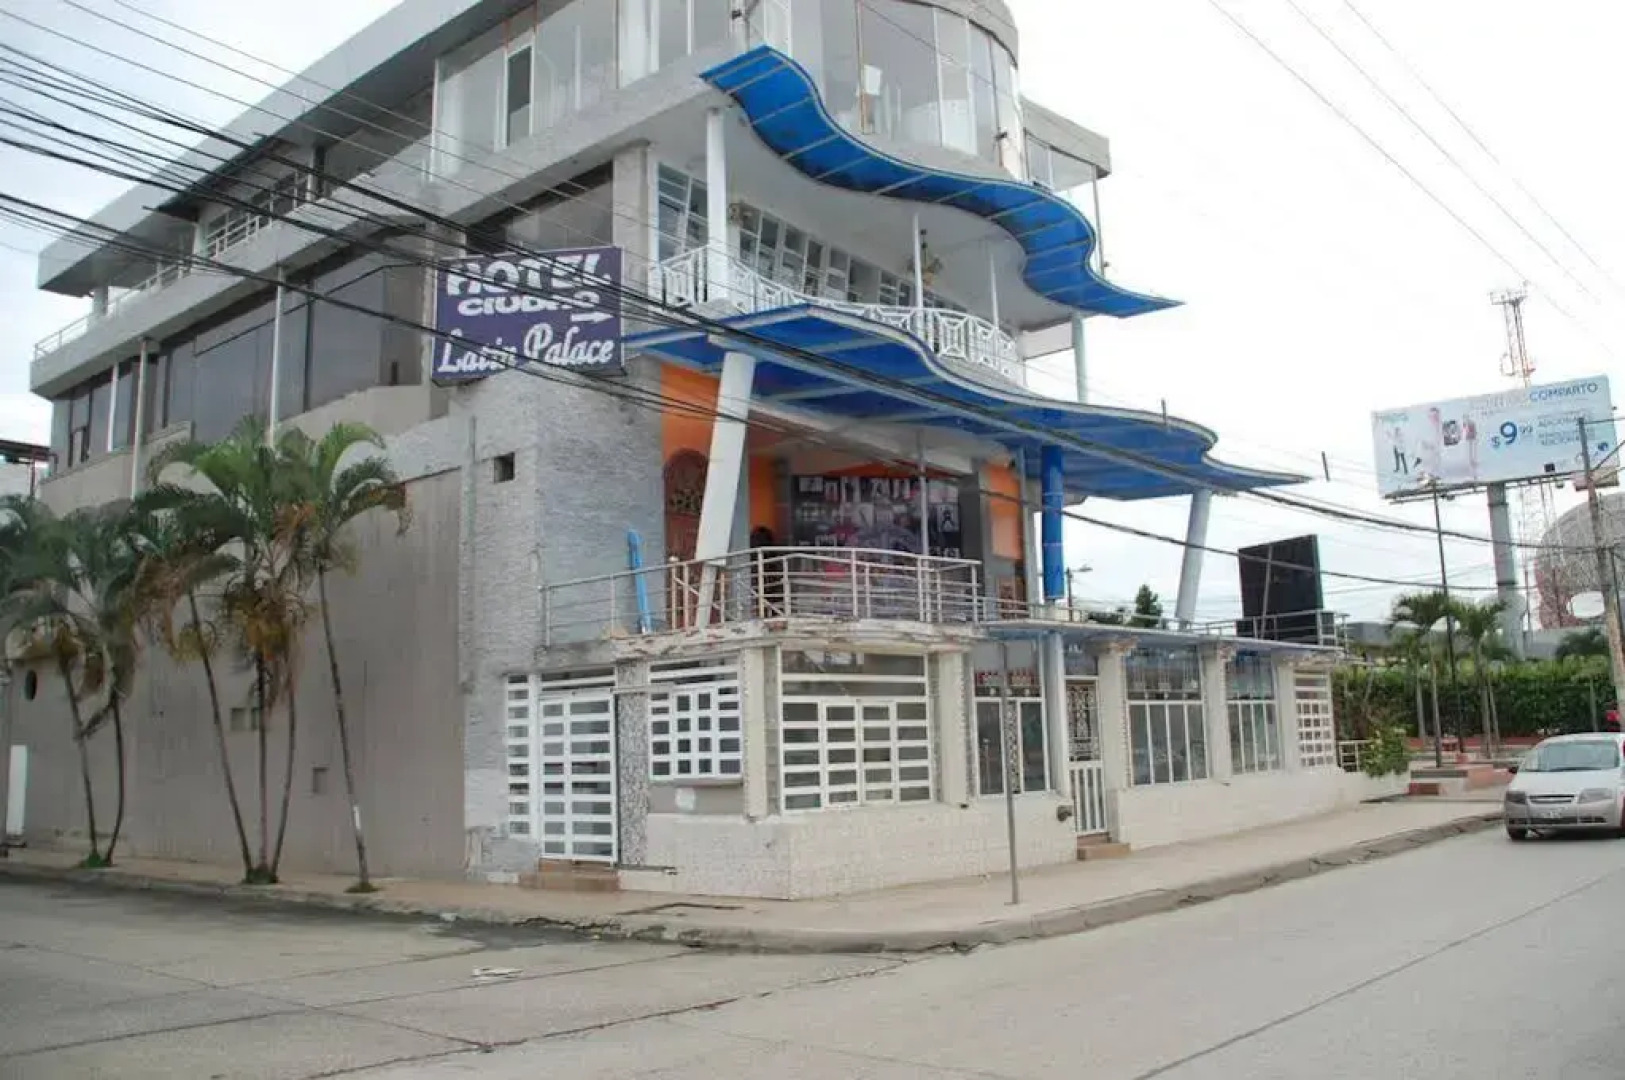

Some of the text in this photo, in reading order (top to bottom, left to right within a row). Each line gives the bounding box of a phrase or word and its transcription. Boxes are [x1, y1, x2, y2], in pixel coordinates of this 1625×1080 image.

[447, 252, 600, 294] HOTEL
[437, 322, 614, 372] Latin Palace
